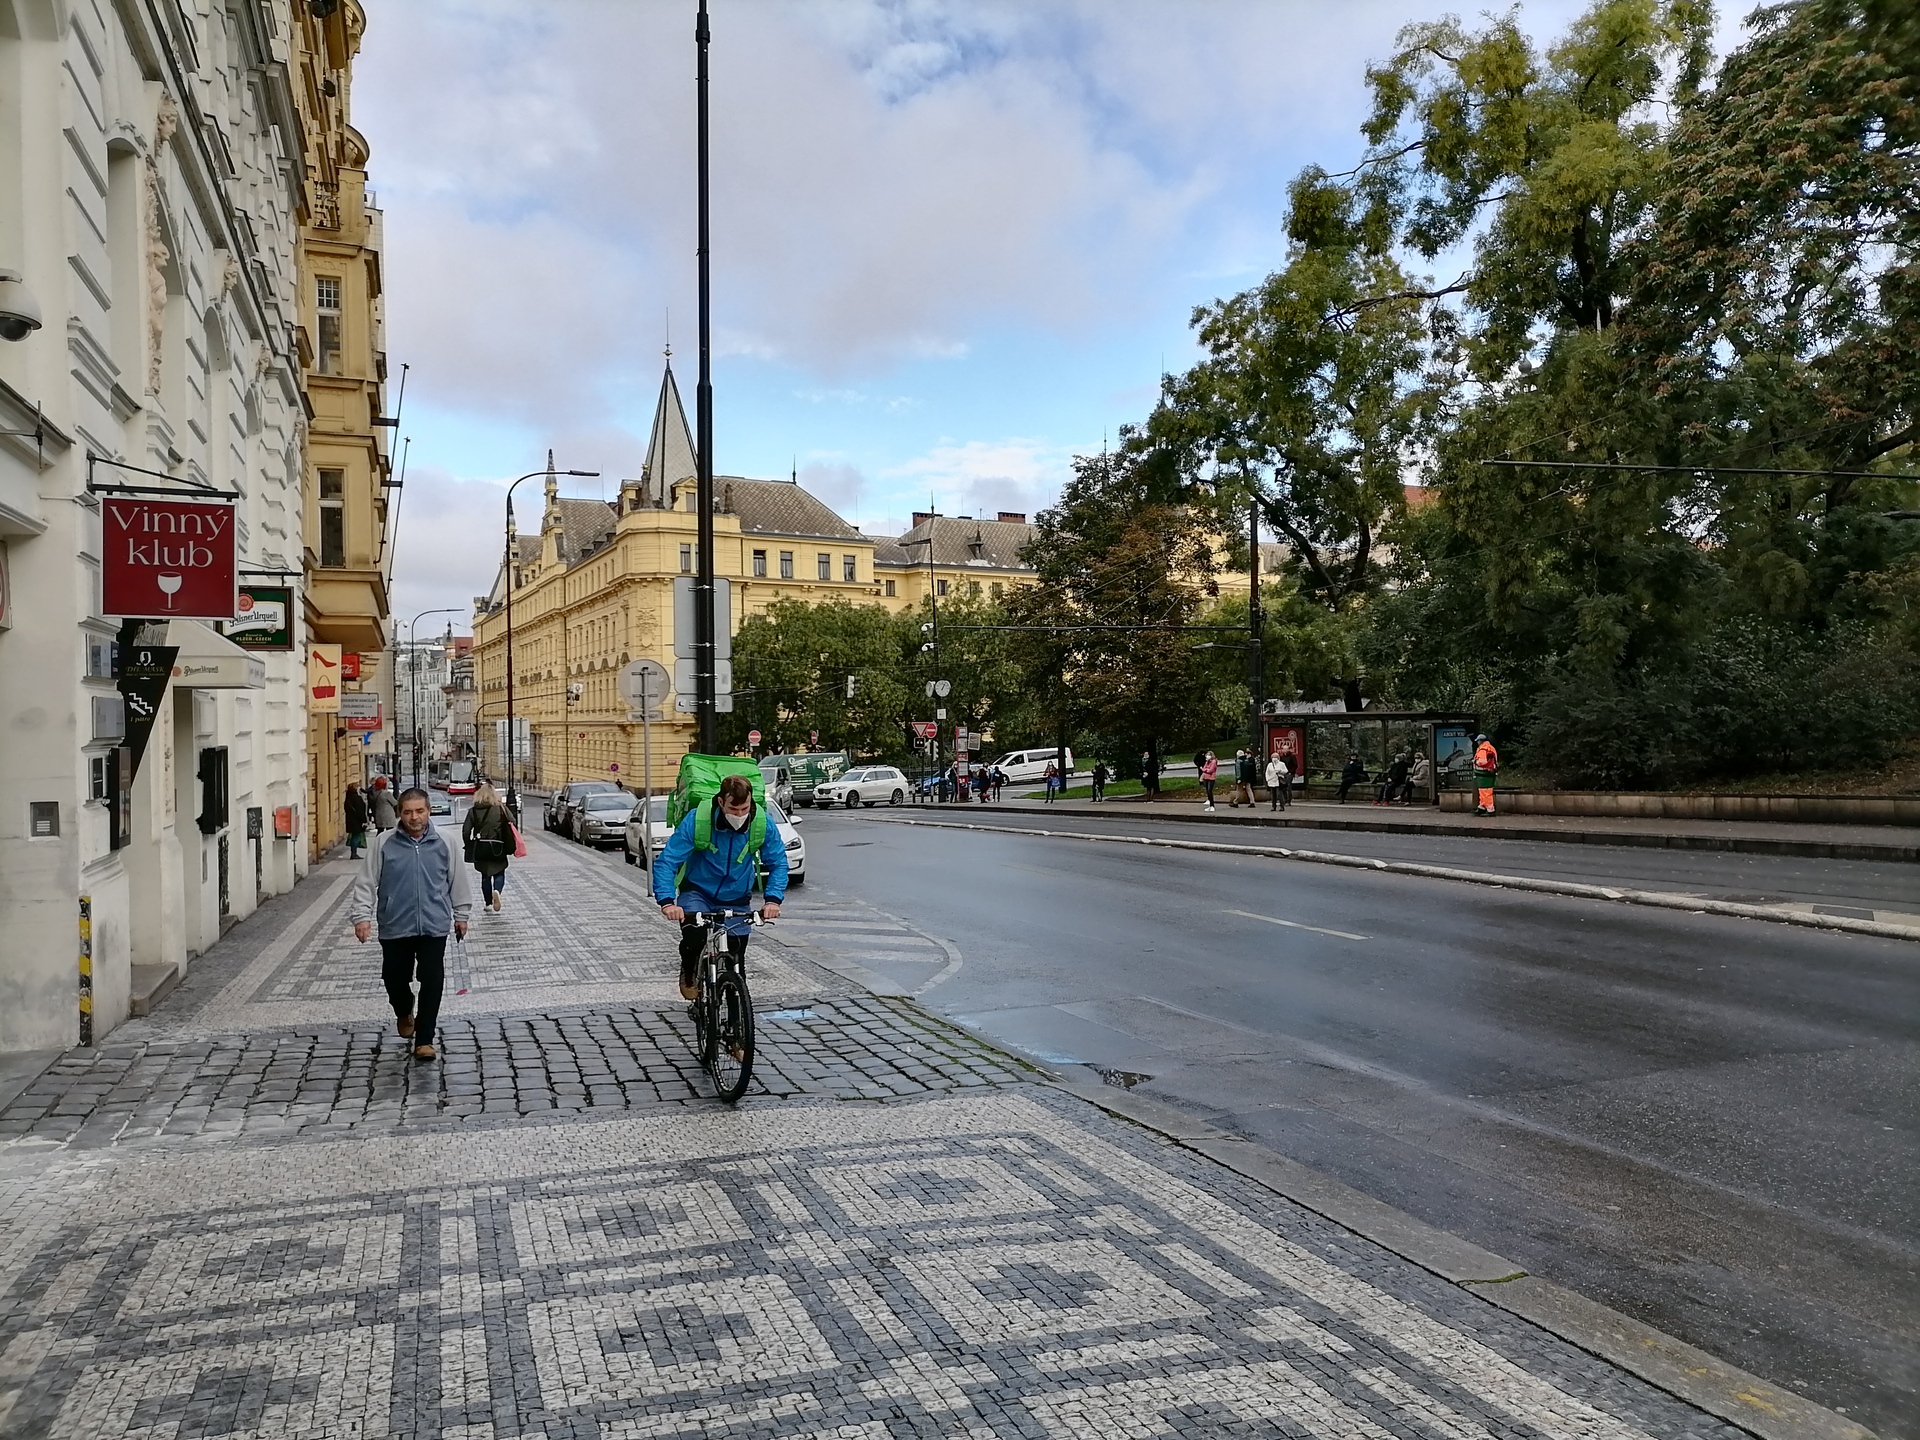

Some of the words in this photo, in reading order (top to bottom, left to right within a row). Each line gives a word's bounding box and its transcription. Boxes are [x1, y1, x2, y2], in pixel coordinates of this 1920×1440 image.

[110, 506, 228, 541] Vinný
[127, 538, 213, 568] klub
[253, 610, 278, 622] Urquell
[1276, 738, 1295, 748] VŽDY
